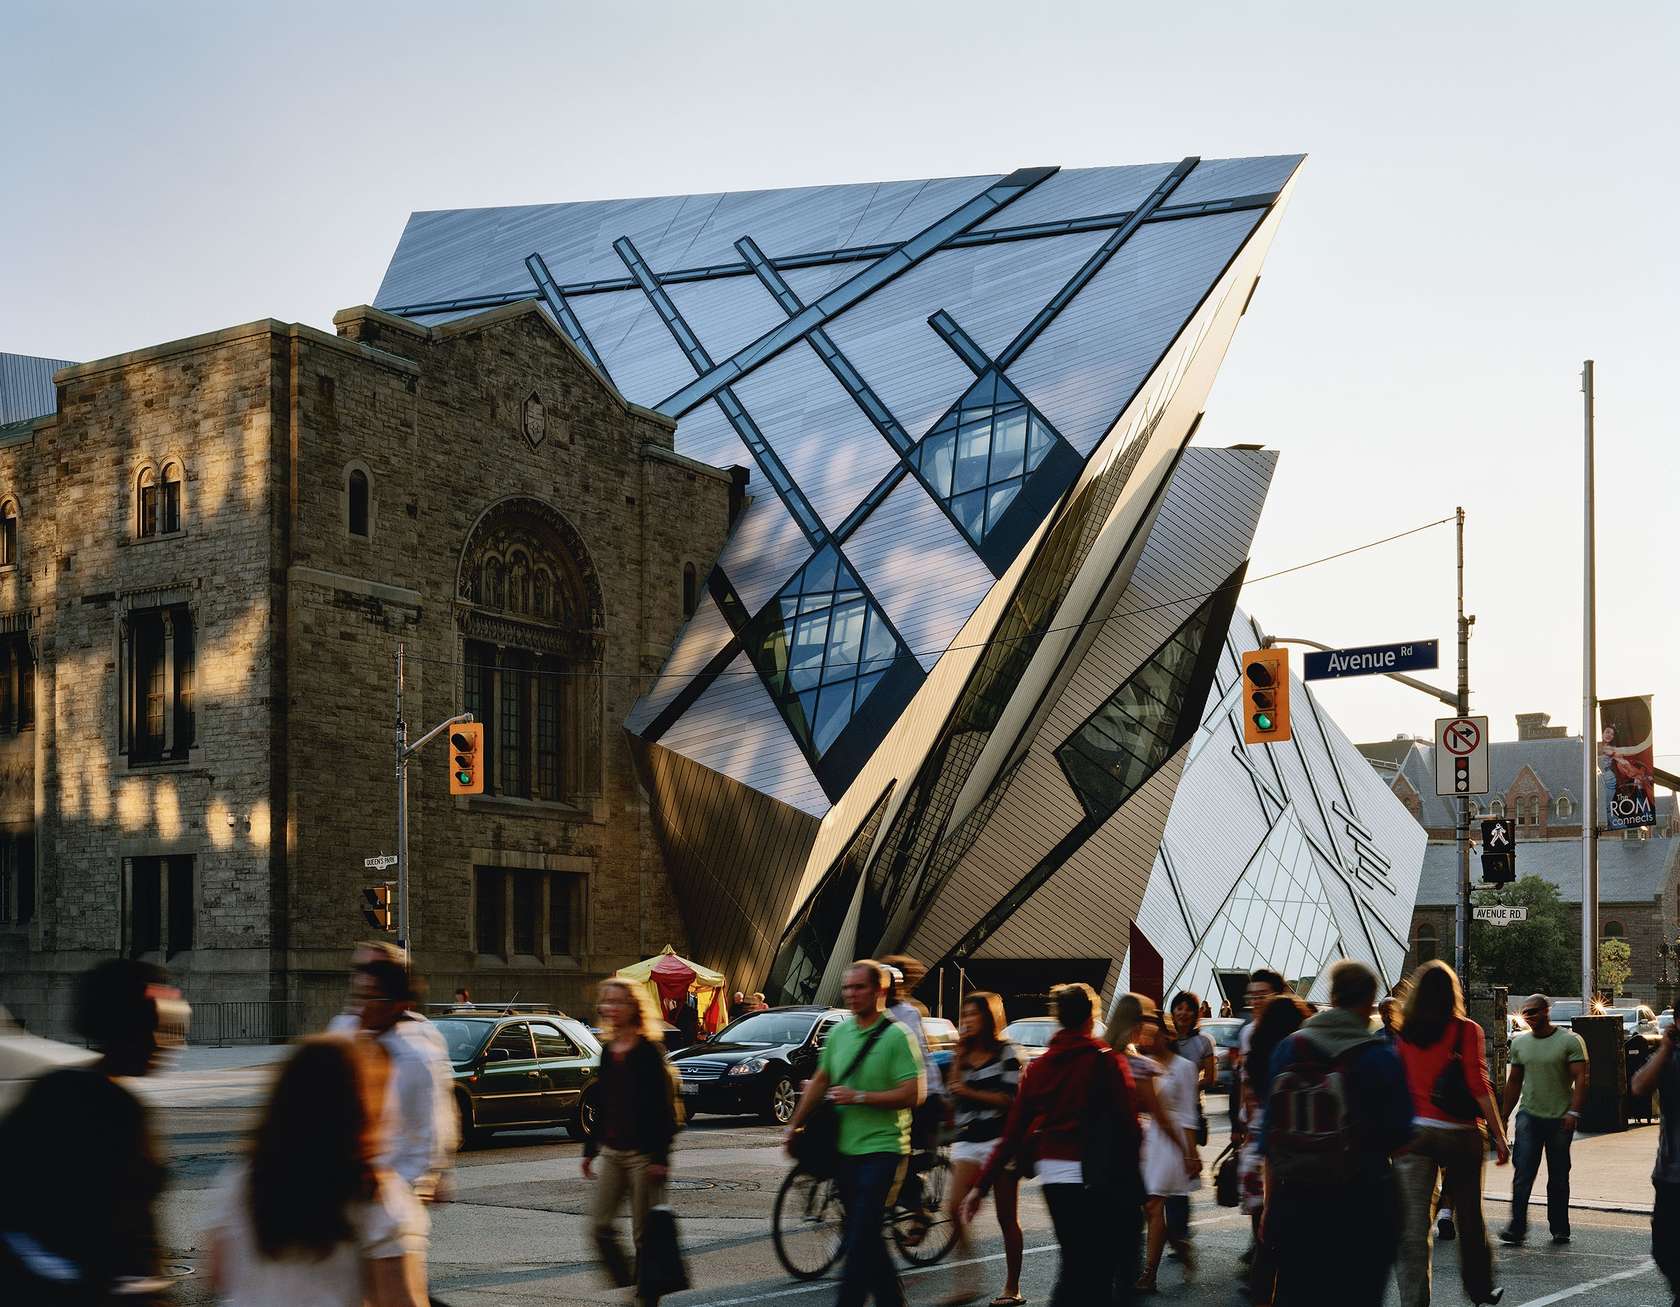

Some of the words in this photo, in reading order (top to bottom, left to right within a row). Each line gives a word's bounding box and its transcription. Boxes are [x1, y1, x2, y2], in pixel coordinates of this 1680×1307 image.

[1328, 652, 1396, 672] Avenue
[1401, 646, 1413, 657] Rd
[1617, 793, 1629, 801] The
[1610, 797, 1651, 817] ROM
[1612, 813, 1653, 826] connects
[1477, 909, 1507, 919] AVENUE
